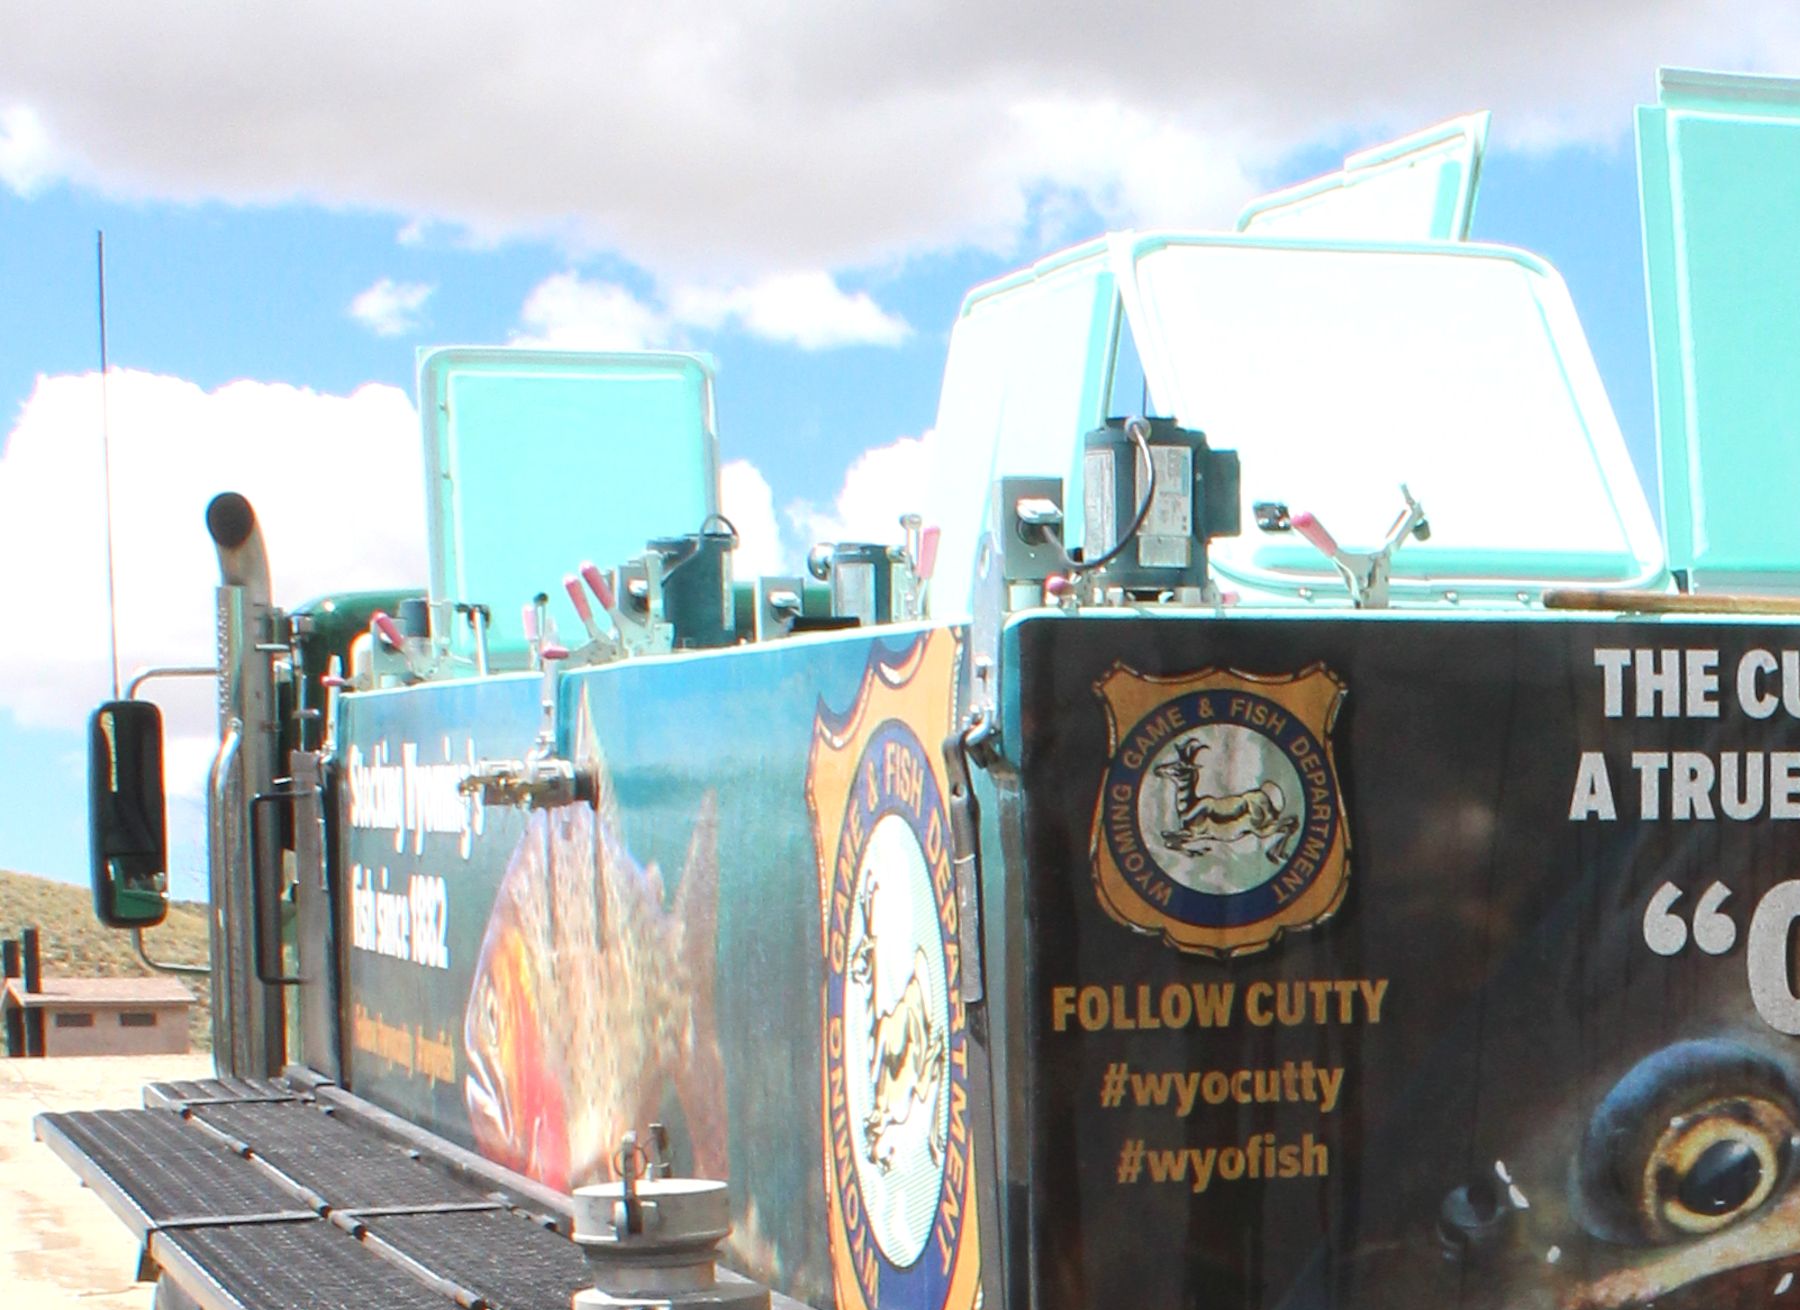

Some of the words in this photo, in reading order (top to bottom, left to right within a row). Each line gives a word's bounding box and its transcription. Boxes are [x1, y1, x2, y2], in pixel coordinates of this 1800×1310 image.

[1199, 697, 1216, 718] &
[1230, 698, 1287, 737] FISH
[1593, 648, 1720, 718] THE
[1123, 705, 1187, 769] GAME
[881, 738, 925, 820] FISH
[1569, 751, 1618, 820] A
[1111, 783, 1174, 906] WYOMING
[1269, 735, 1332, 904] DEPARTMENT
[830, 796, 866, 976] GAME
[1052, 982, 1237, 1032] FOLLOW
[1244, 979, 1390, 1027] CUTTY
[1100, 1060, 1345, 1118] #wyocutty
[828, 1015, 880, 1310] WYOMING
[1117, 1131, 1330, 1194] #wyofish
